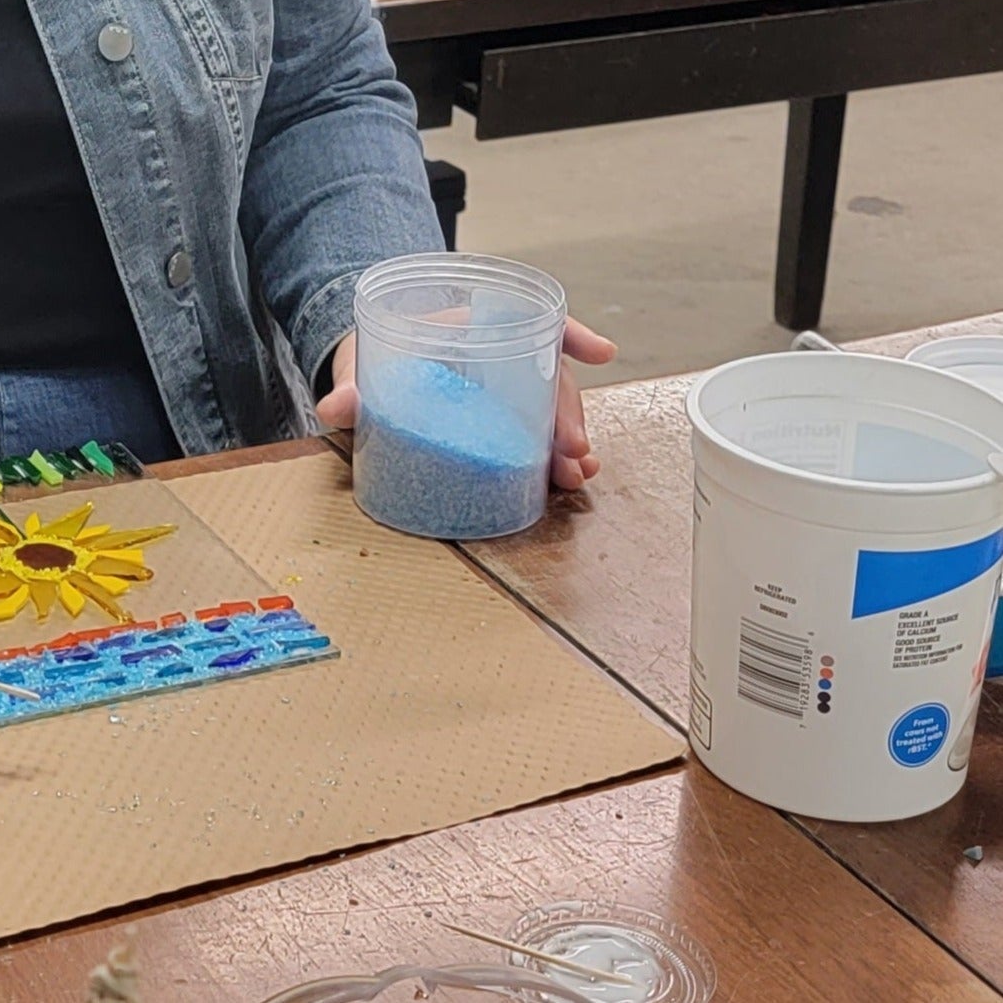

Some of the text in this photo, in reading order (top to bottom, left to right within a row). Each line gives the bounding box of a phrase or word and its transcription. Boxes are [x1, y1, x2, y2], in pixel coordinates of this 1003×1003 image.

[767, 583, 783, 593] KEEP
[754, 584, 797, 605] REFRIGERATED
[899, 611, 922, 619] GRADE
[898, 613, 959, 629] EXCELLENT SOURCE
[907, 627, 937, 637] CALCIUM
[895, 635, 941, 646] GOOD SOURCE
[905, 644, 933, 653] PROTEIN
[913, 718, 934, 727] From
[904, 724, 939, 737] cows not
[896, 731, 944, 746] treated with
